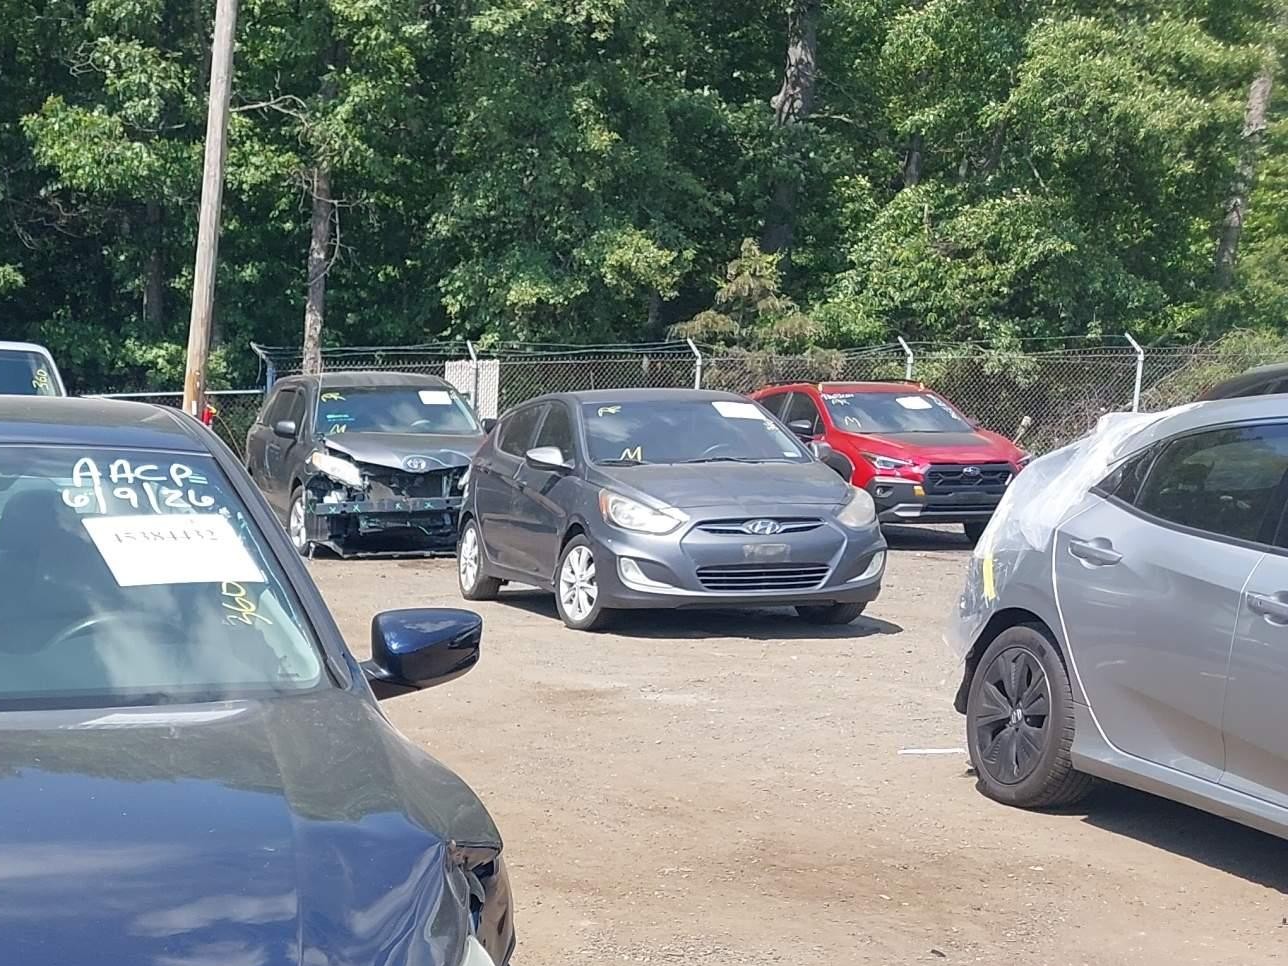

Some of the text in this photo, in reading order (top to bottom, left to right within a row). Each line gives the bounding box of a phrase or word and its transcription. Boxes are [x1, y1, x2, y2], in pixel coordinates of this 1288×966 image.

[32, 369, 49, 391] 360
[619, 446, 642, 463] M
[62, 481, 216, 515] 6/9/26
[220, 580, 274, 626] 360
